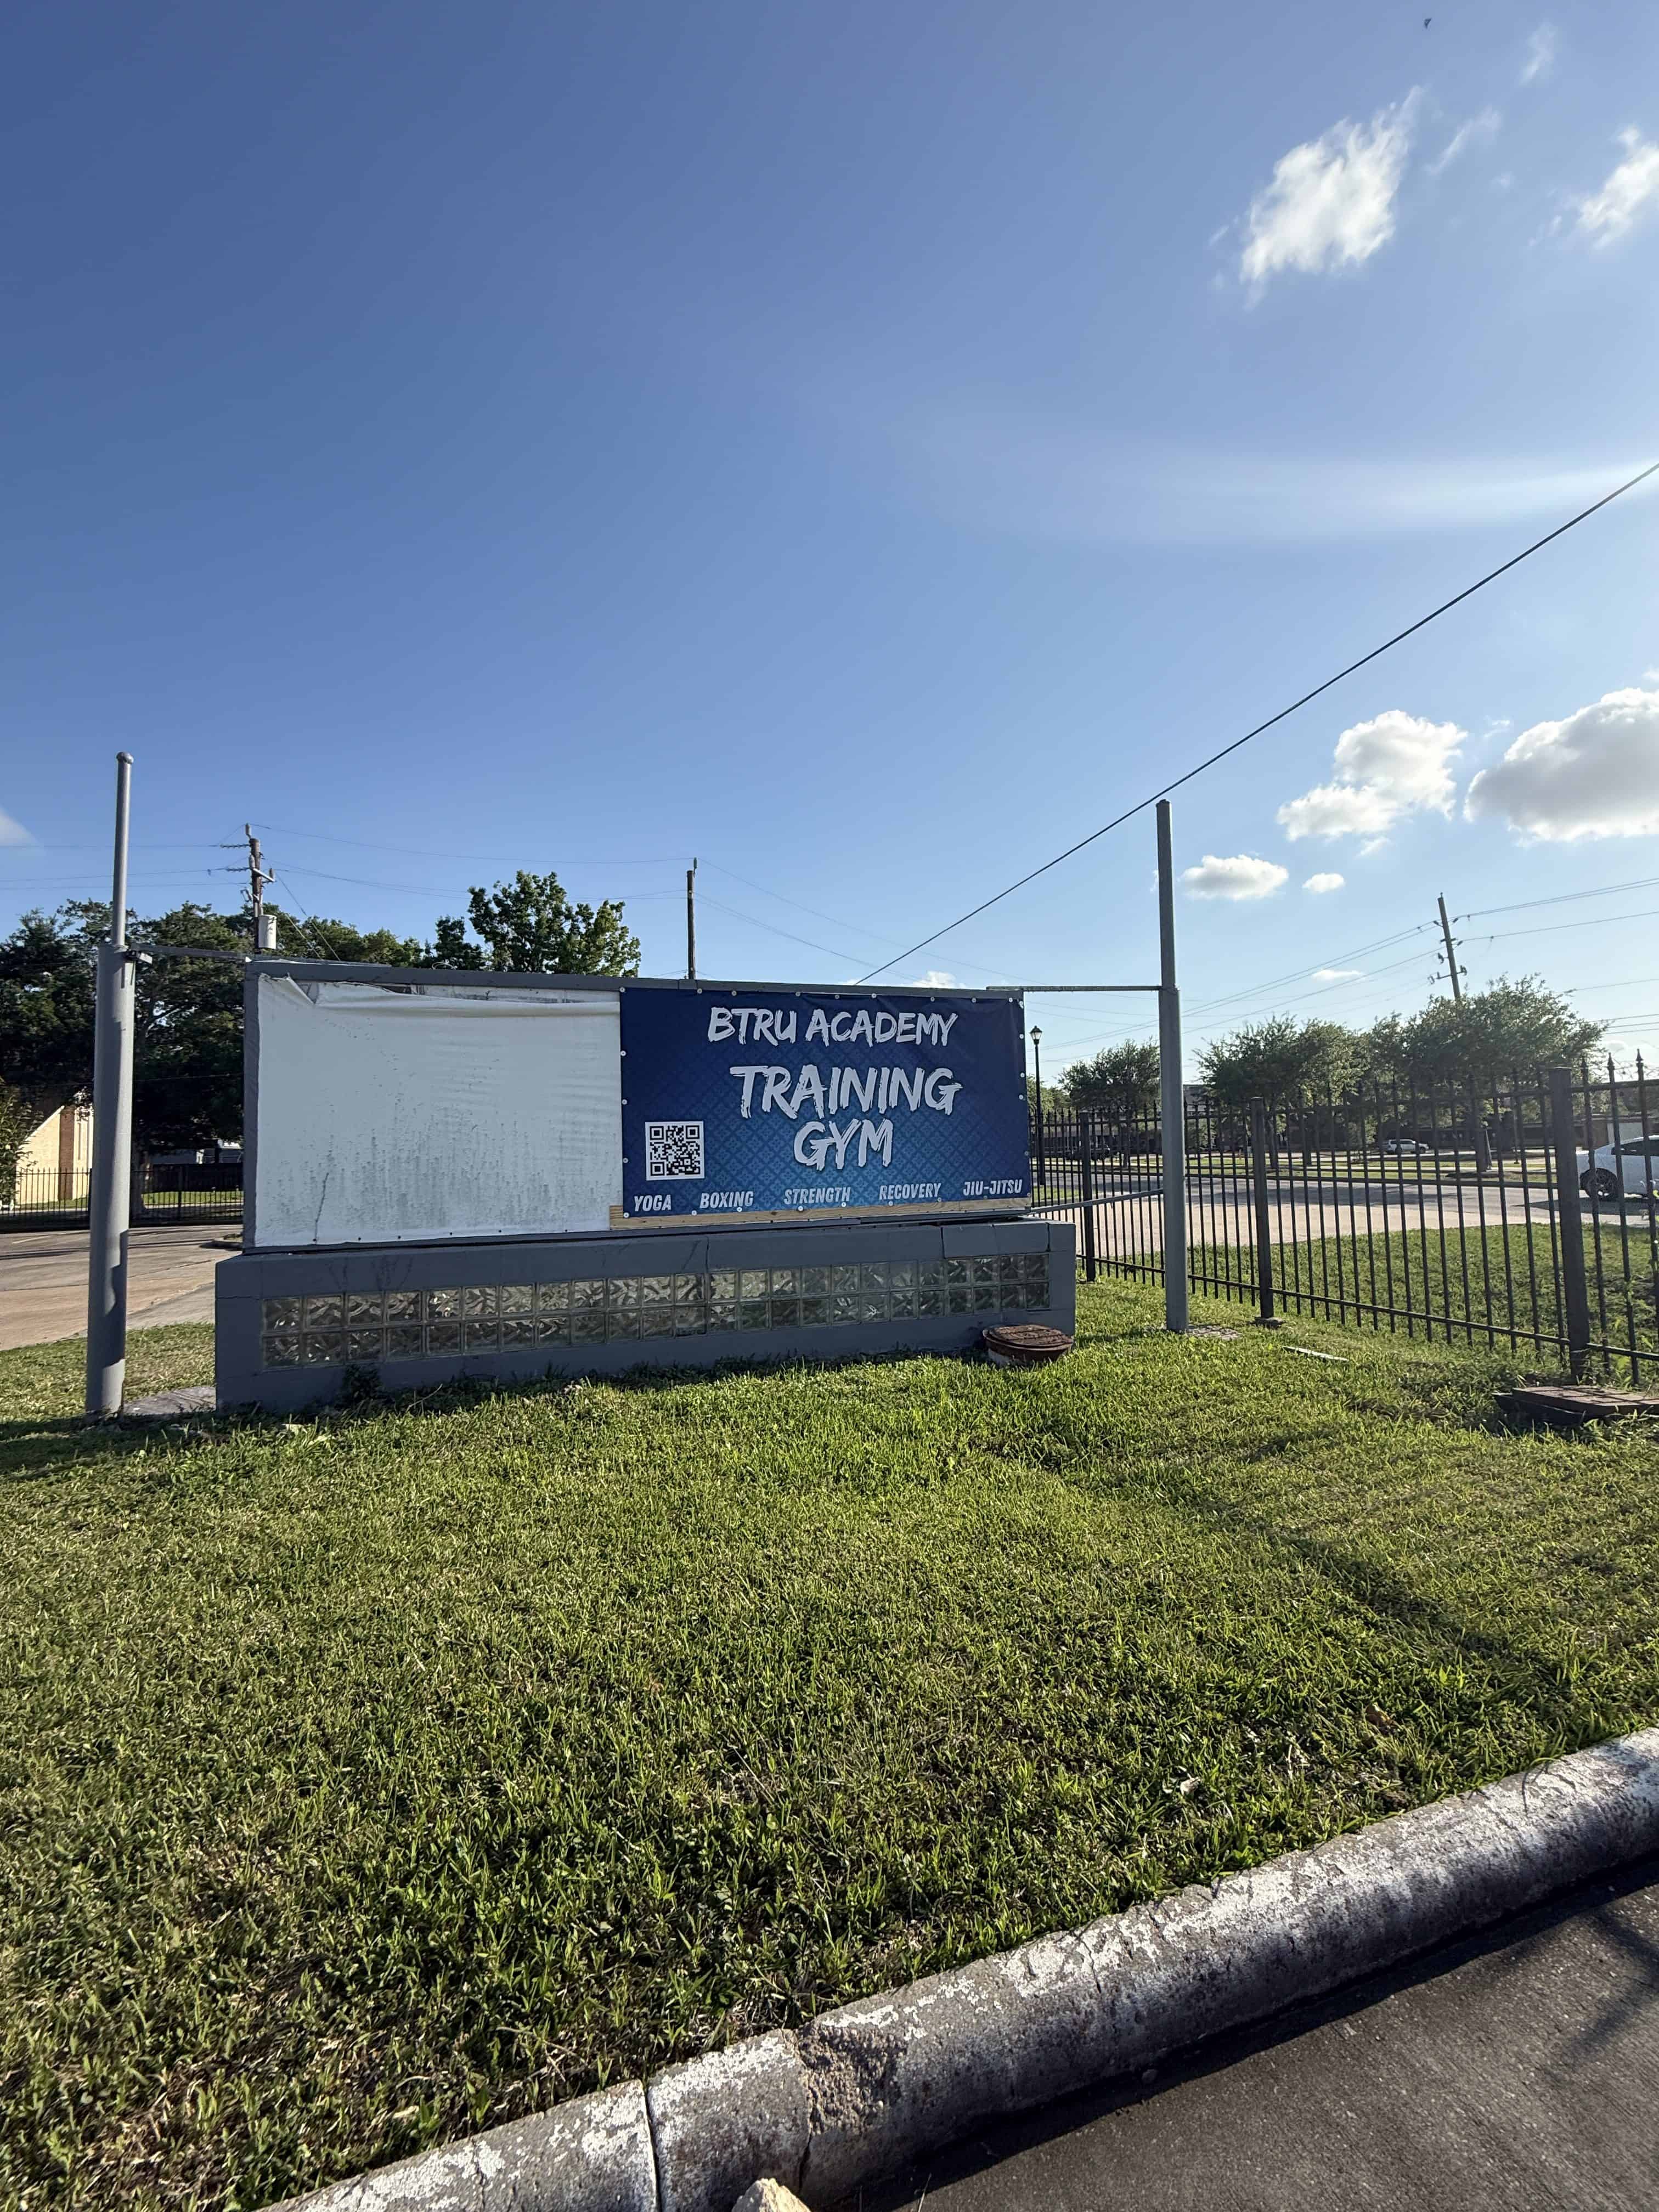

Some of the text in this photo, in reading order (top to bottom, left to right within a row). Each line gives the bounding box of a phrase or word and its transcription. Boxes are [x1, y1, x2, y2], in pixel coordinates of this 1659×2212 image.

[708, 1007, 958, 1047] BTRU ACADEMY
[730, 1064, 963, 1119] TRAINING
[794, 1119, 893, 1171] GYM
[634, 1180, 1023, 1212] YOGA BOXING STRENGTH RECOVERY JIU-JITSU
